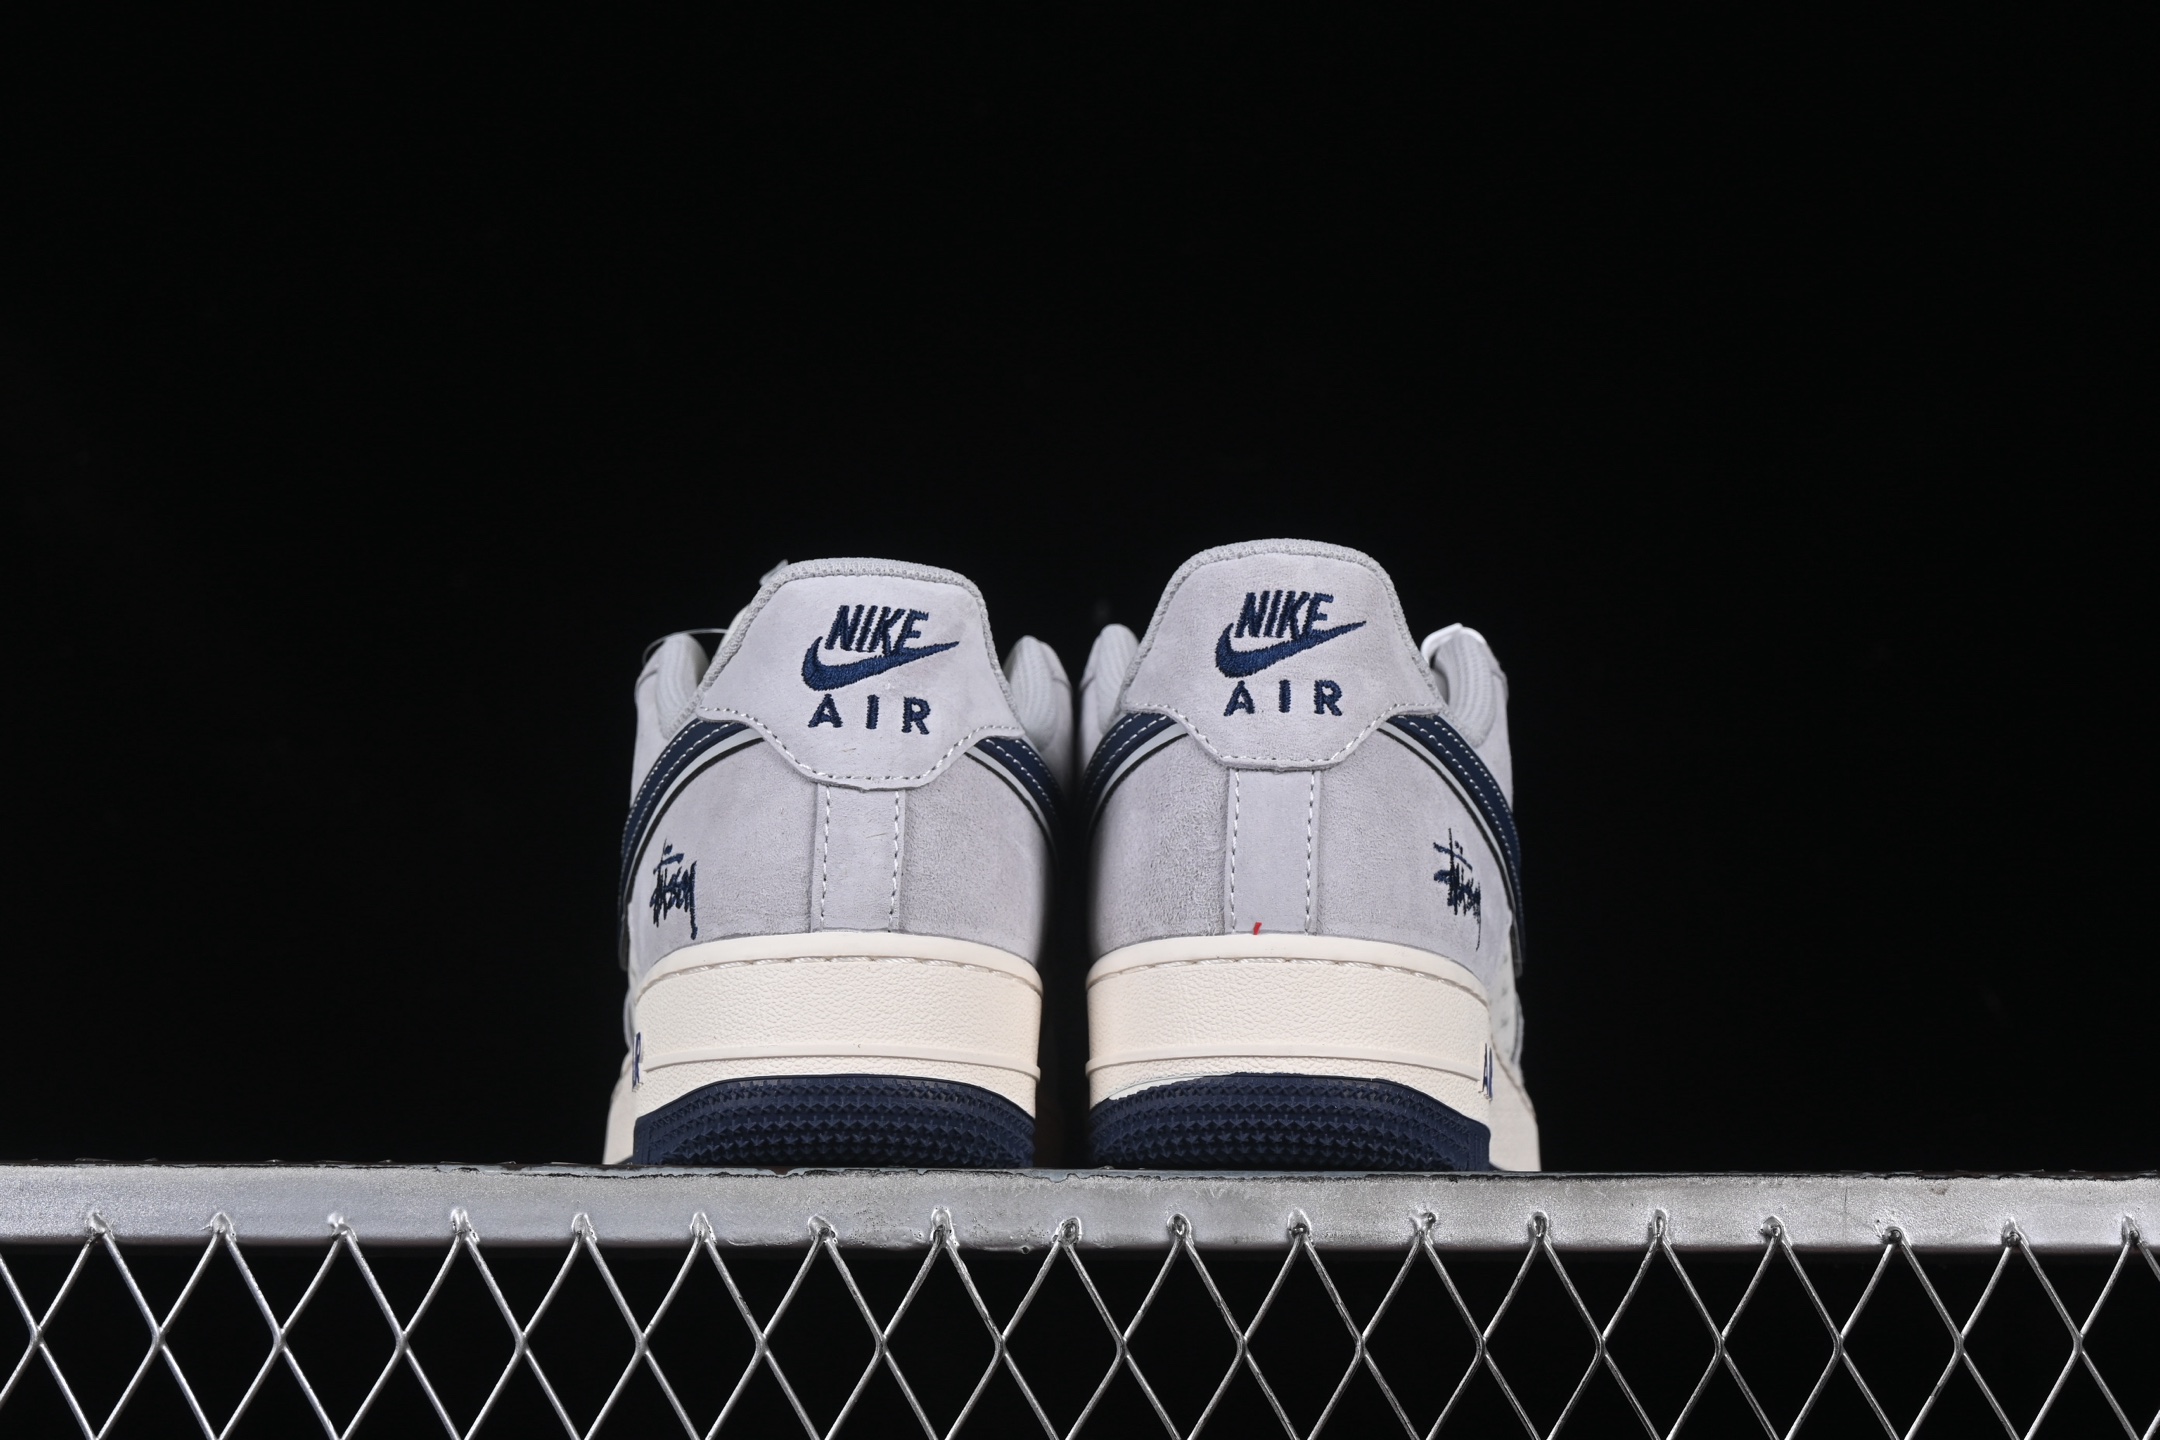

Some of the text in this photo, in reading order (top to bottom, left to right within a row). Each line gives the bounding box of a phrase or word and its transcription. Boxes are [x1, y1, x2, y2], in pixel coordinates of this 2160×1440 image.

[825, 604, 929, 655] NIKE
[1234, 590, 1334, 642] NIKE
[808, 693, 931, 735] AIR
[1223, 679, 1343, 717] AIR
